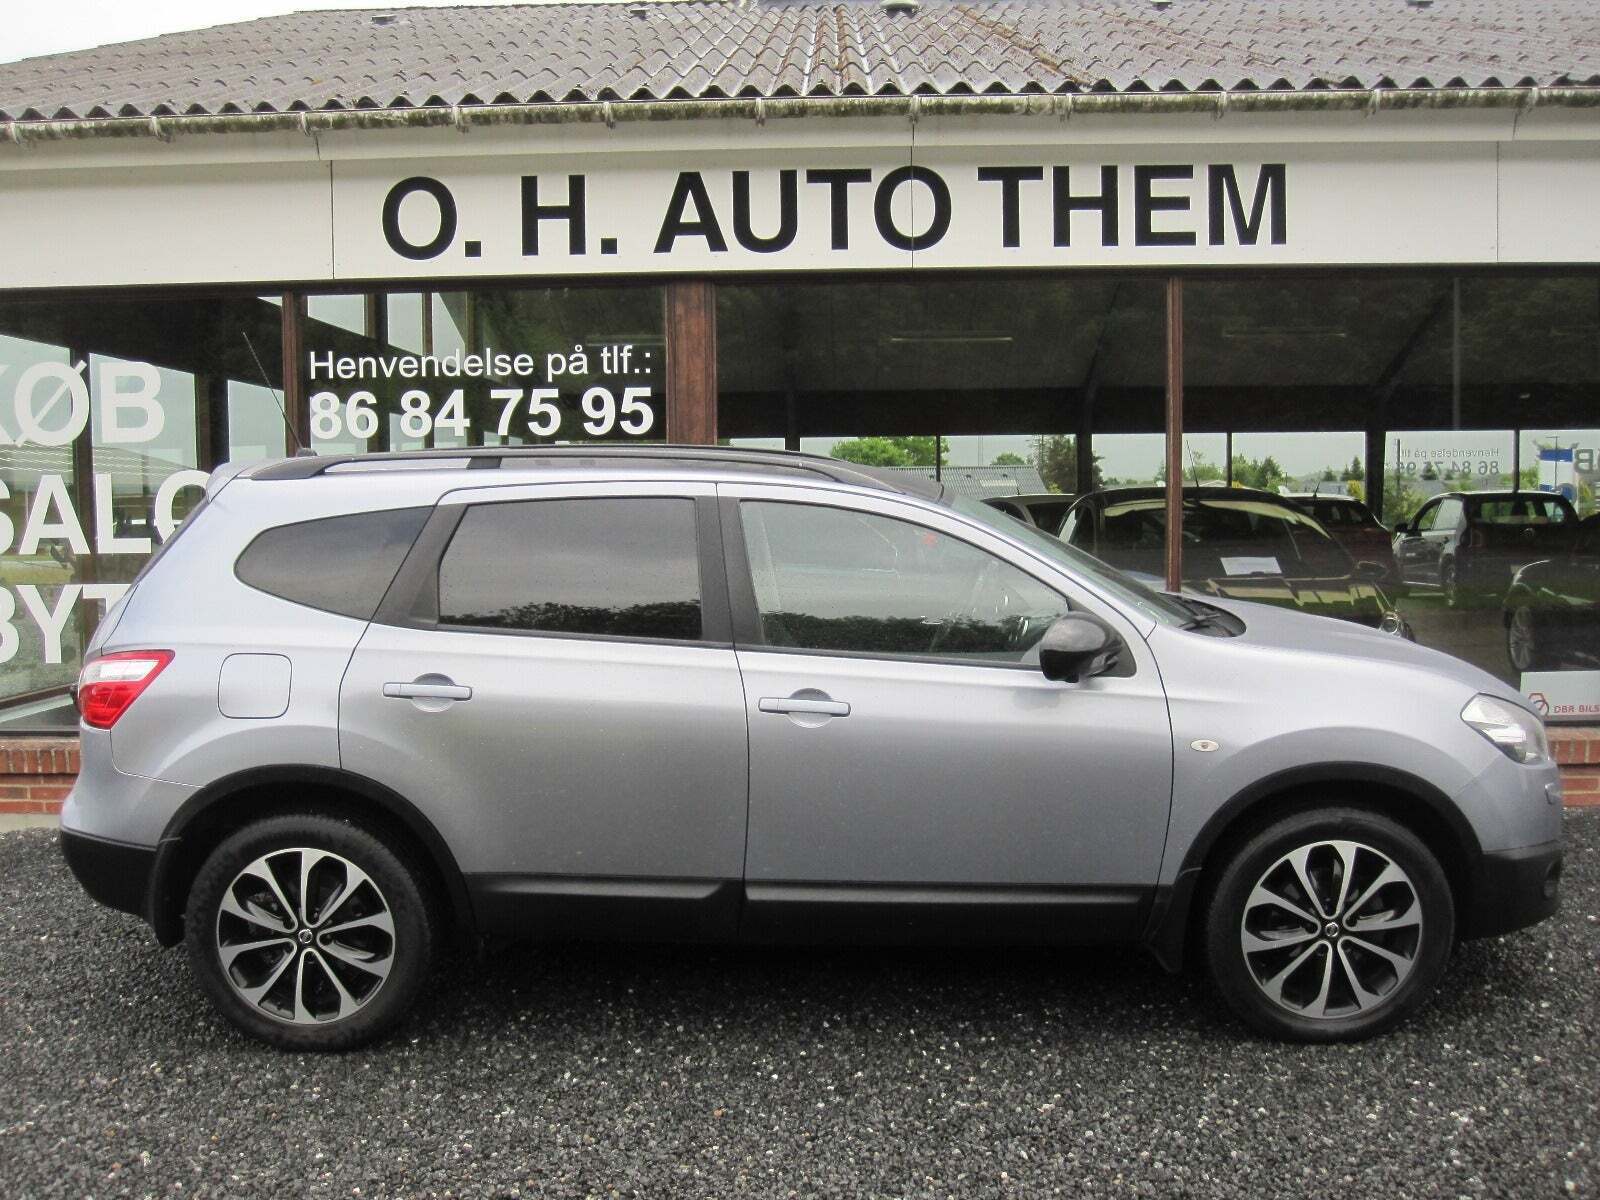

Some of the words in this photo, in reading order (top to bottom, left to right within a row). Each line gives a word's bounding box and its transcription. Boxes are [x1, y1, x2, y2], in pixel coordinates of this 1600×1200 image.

[381, 175, 482, 261] O.
[521, 174, 618, 256] H.
[653, 164, 952, 254] AUTO
[977, 163, 1287, 248] THEM
[309, 348, 535, 380] Henvendelse
[547, 344, 589, 383] på
[600, 344, 652, 375] tlf.:
[0, 359, 166, 448] ØB
[309, 390, 379, 440] 86
[399, 388, 471, 439] 84
[490, 388, 562, 437] 75
[581, 386, 654, 436] 95
